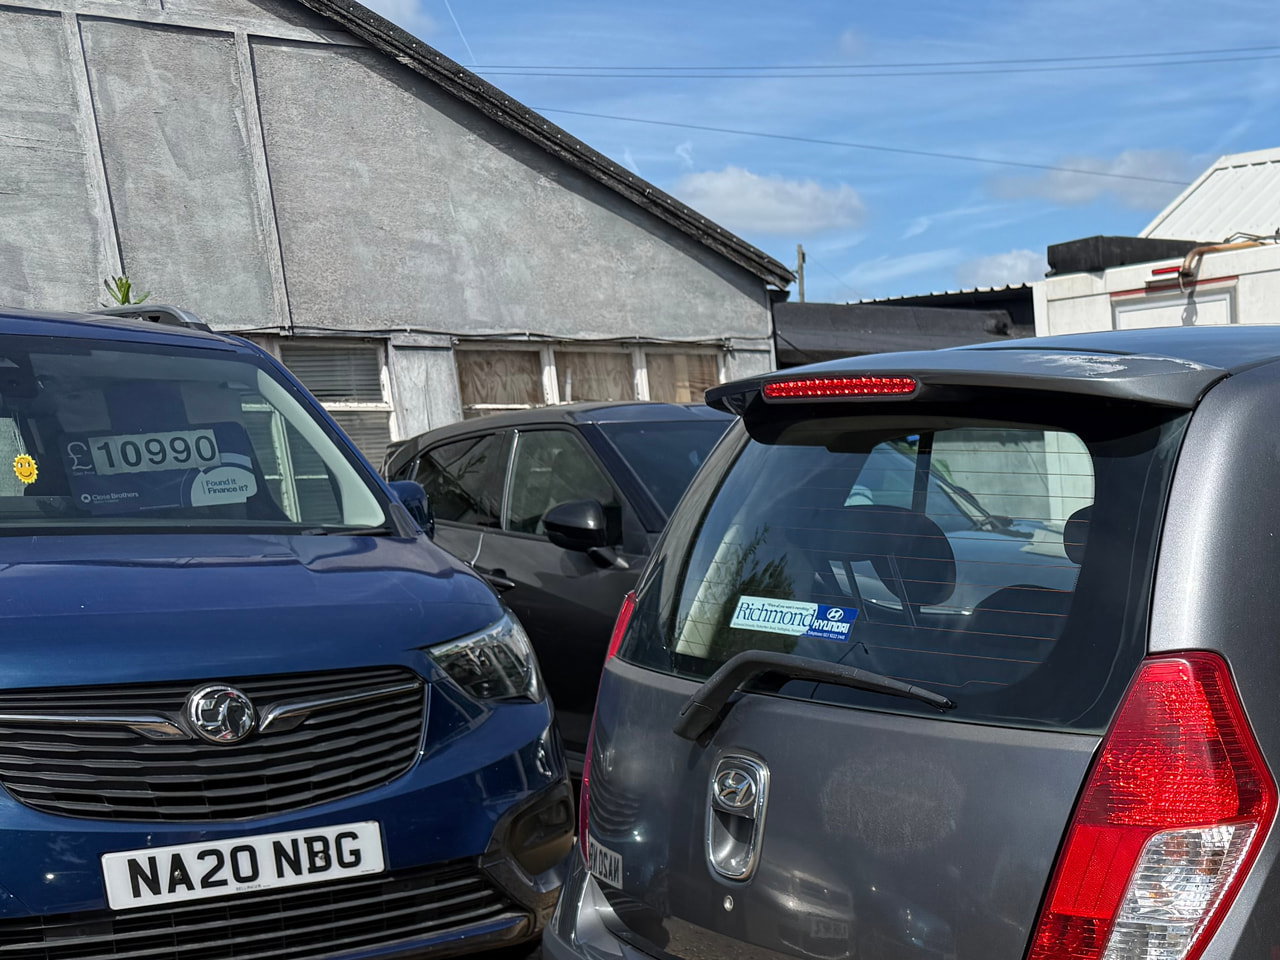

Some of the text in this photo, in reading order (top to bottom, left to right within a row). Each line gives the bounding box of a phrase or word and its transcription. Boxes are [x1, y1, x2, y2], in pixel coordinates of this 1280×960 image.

[206, 478, 230, 487] Found
[208, 484, 238, 494] Finance
[736, 602, 817, 628] Richmond
[813, 619, 851, 634] HYUNDAI
[127, 831, 362, 899] NA20 NBG
